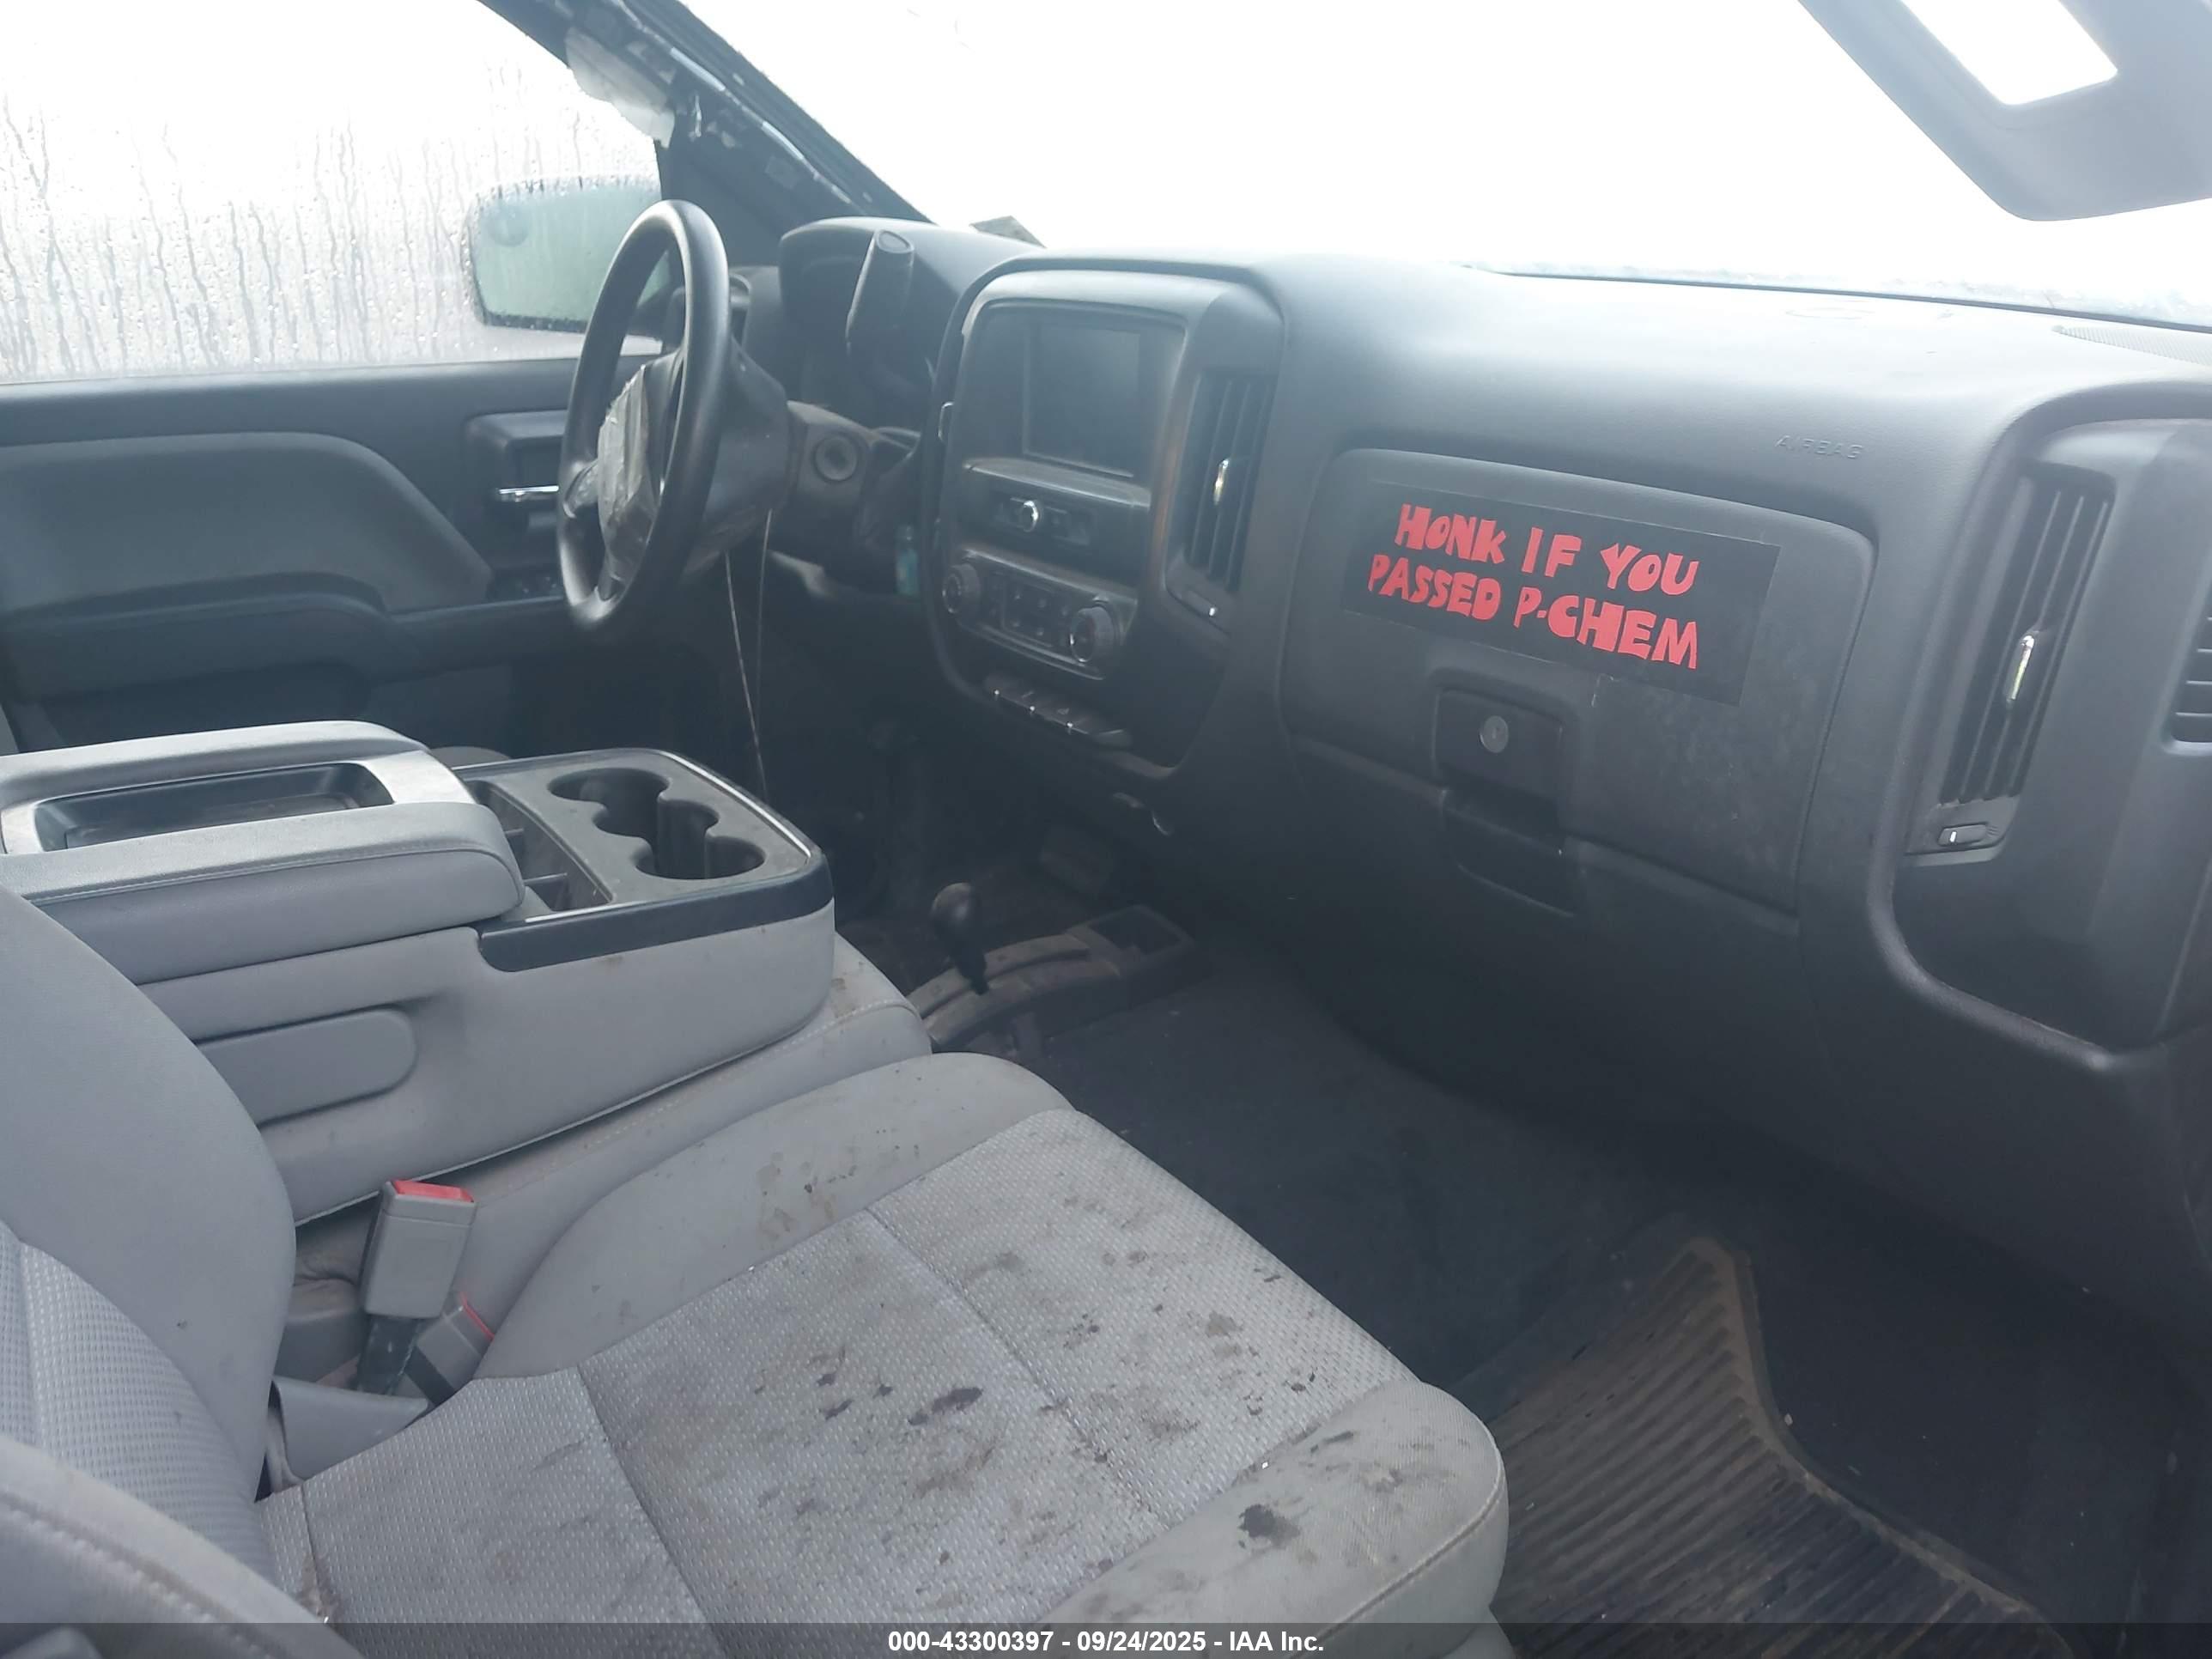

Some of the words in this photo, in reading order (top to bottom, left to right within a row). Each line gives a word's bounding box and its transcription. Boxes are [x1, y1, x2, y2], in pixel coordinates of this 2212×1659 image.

[1395, 503, 1505, 564] HONK
[1522, 526, 1582, 578] IF
[1600, 544, 1698, 595] YOU
[1368, 554, 1502, 621] PASSED
[1514, 586, 1698, 670] P-CHEM
